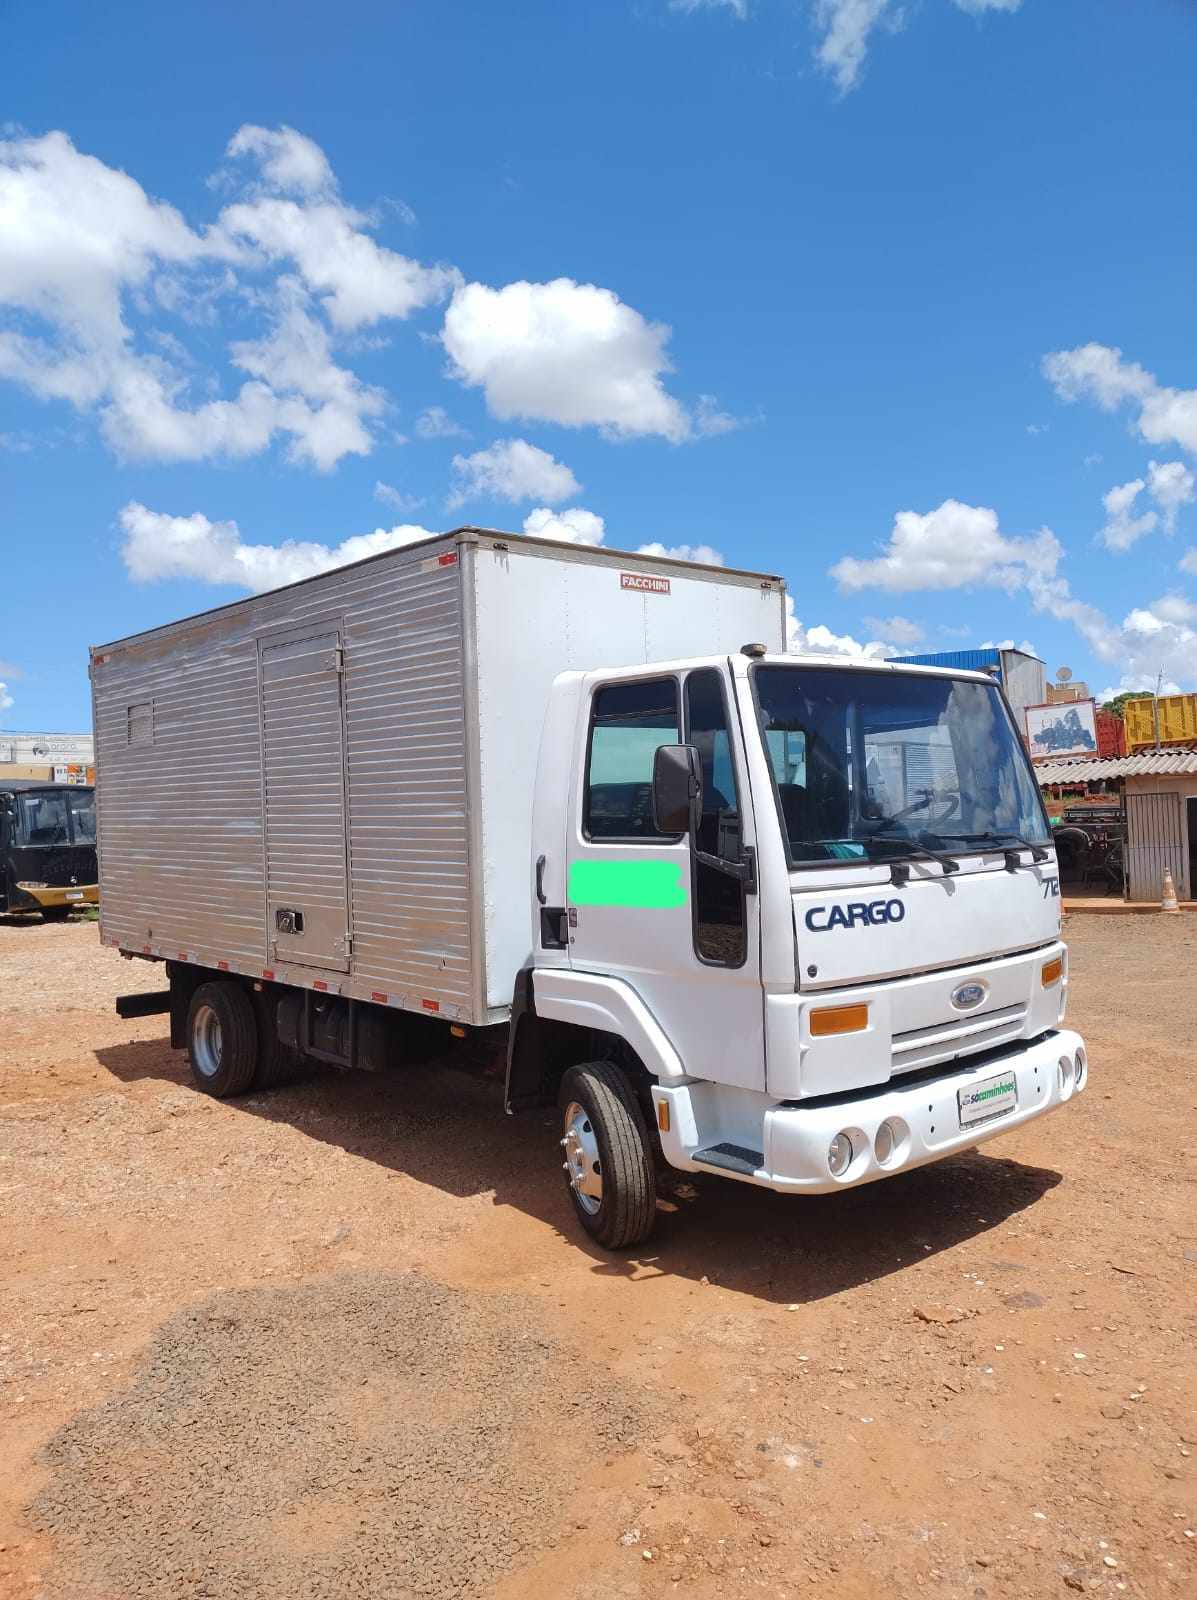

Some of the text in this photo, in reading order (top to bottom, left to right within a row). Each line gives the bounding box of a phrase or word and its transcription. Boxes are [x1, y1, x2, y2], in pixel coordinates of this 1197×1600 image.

[622, 575, 670, 592] FACCHINI
[1041, 877, 1059, 899] 712
[805, 899, 905, 932] CARGO
